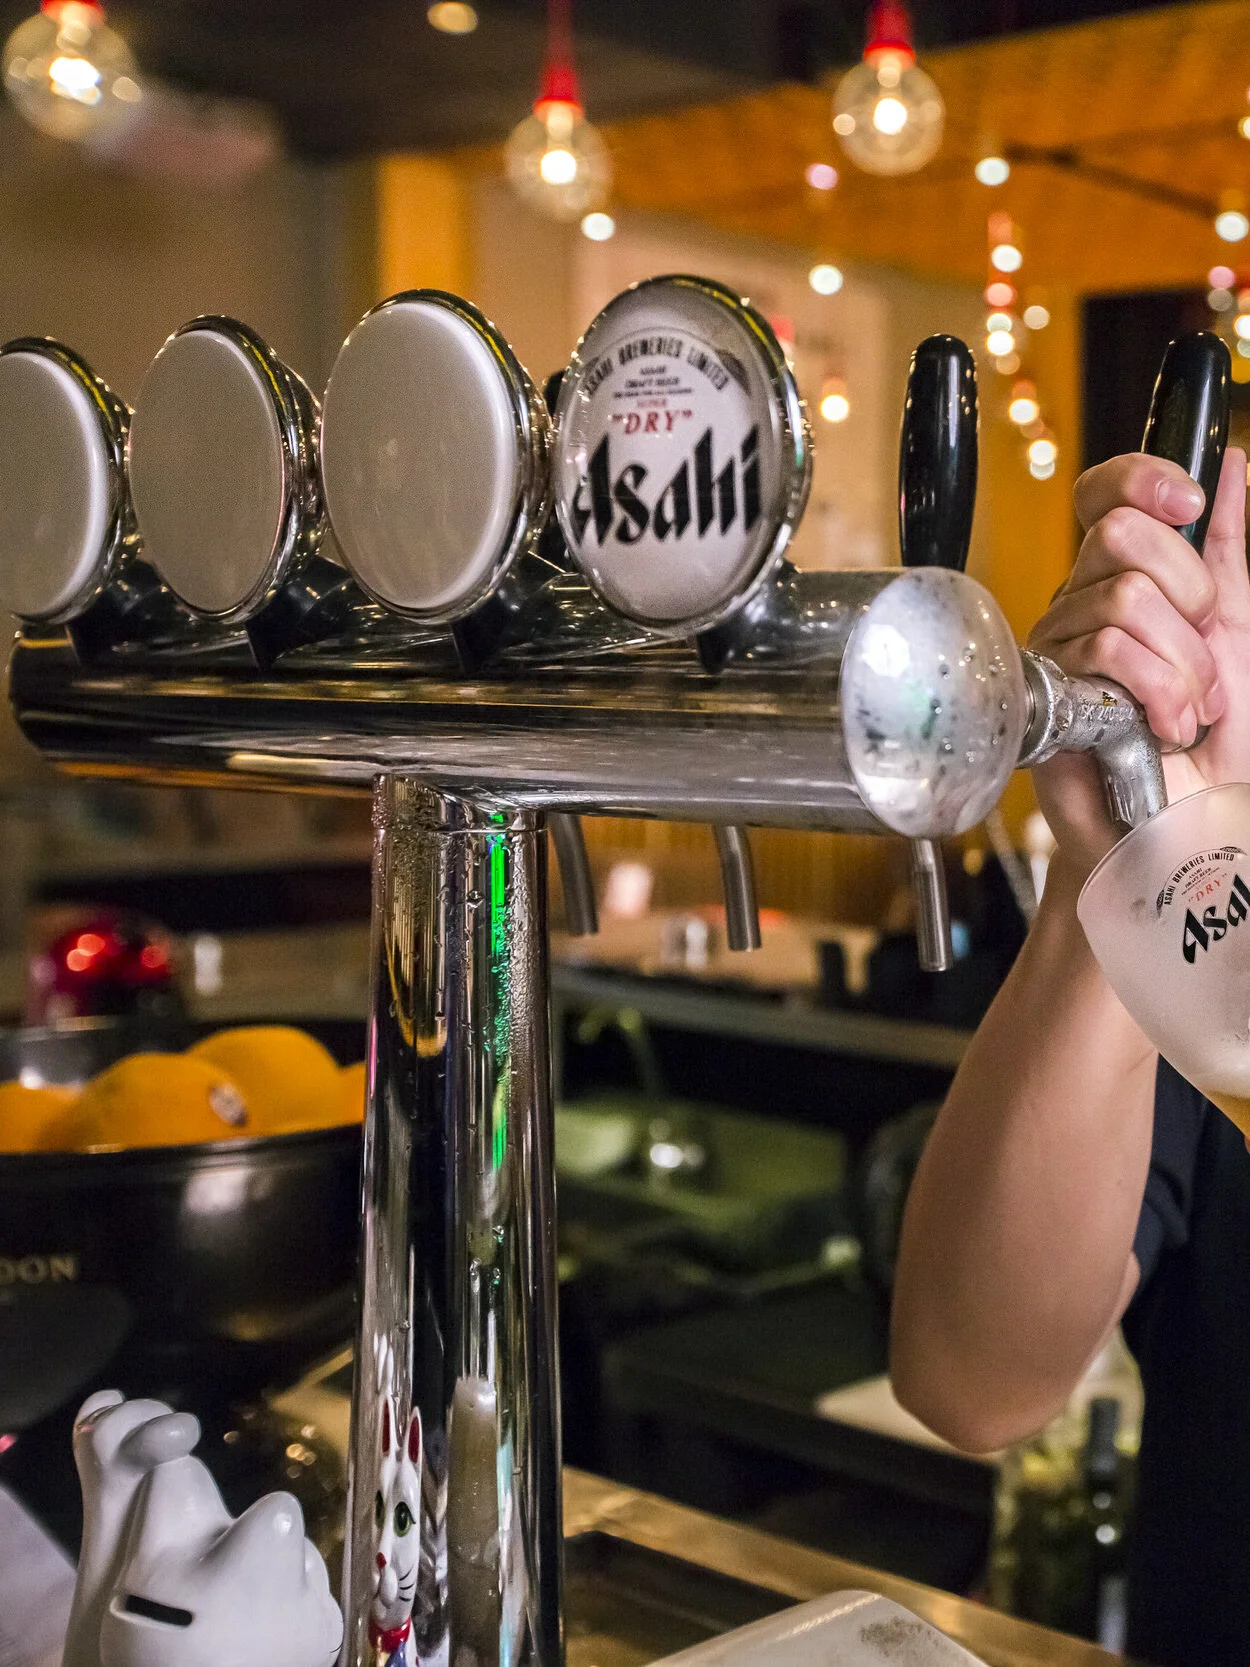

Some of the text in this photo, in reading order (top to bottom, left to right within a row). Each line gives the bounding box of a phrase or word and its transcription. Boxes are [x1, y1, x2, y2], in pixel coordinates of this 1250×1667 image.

[618, 336, 683, 366] BREWERIES
[687, 347, 729, 391] LIMITED
[572, 424, 761, 546] Asahi
[1163, 885, 1176, 906] ASAHI
[1172, 855, 1205, 884] BREWERIES
[1207, 852, 1235, 862] LIMITED
